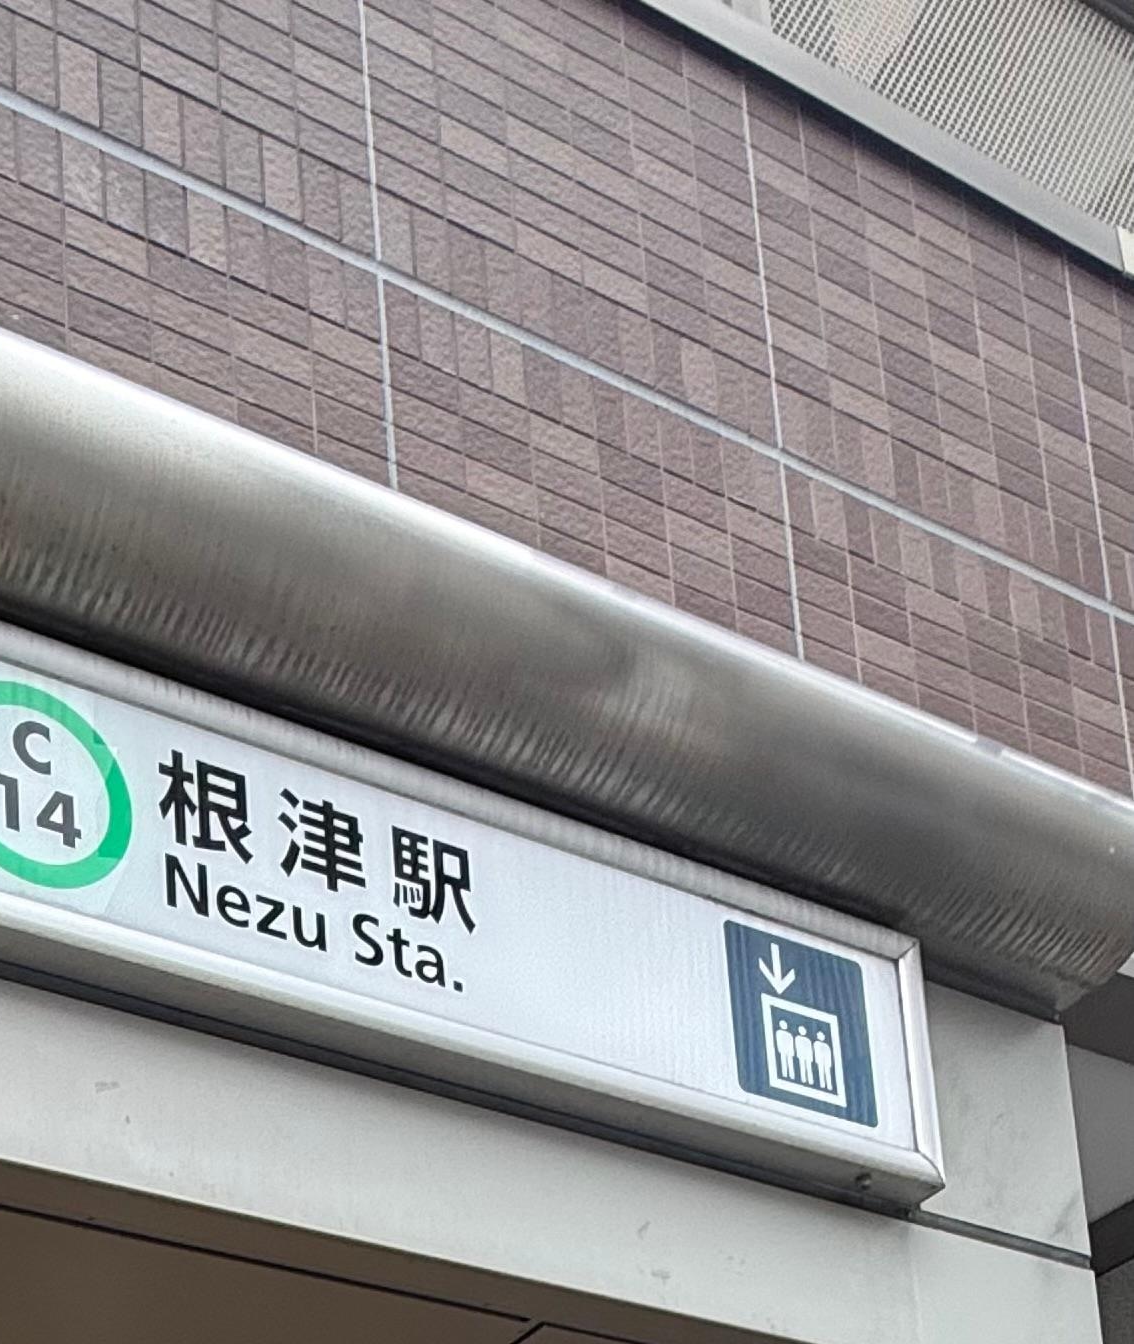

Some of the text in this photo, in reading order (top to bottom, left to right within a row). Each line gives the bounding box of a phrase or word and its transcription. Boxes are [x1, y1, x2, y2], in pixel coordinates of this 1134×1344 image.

[11, 721, 52, 775] C
[157, 749, 476, 935] 根津駅
[166, 854, 465, 993] Nezu Sta.
